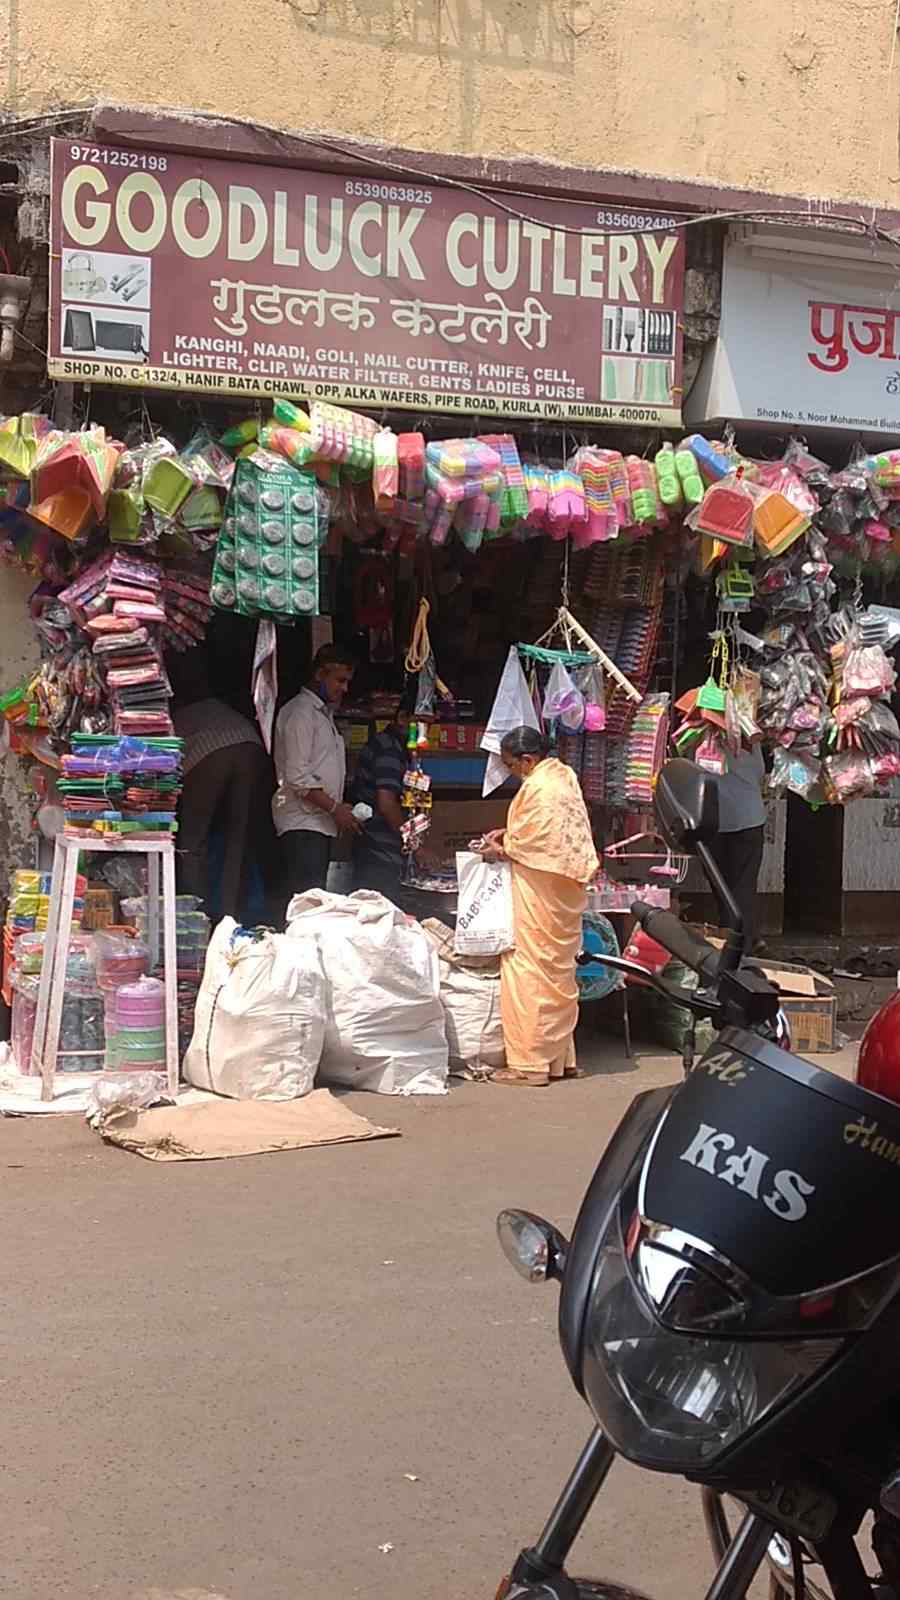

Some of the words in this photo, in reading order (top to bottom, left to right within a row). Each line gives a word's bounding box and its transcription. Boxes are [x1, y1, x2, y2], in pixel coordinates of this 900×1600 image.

[70, 145, 168, 172] 9721252198
[344, 180, 433, 204] 8539063825
[61, 164, 426, 281] GOODLUCK
[445, 211, 679, 304] CUTLERY
[210, 278, 380, 336] गुडलक
[390, 292, 552, 350] कटलेरी
[163, 352, 243, 373] LIGHTER,
[248, 359, 288, 377] CLIP,
[293, 363, 349, 380] WATER
[355, 369, 414, 387] FILTER,
[419, 375, 472, 391] GENTS
[476, 378, 531, 395] LADIES
[537, 385, 585, 400] PURSE
[175, 335, 249, 356] KANGHI,
[253, 342, 310, 362] NAADI,
[315, 348, 359, 366] GOLI,
[364, 353, 401, 368] NAIL
[406, 356, 474, 377] CUTTER,
[478, 363, 529, 382] KNIFE,
[533, 368, 575, 385] CELL,
[64, 361, 100, 375] SHOP
[104, 365, 127, 379] NO.
[185, 372, 224, 387] HANIF
[228, 376, 260, 390] BATA
[264, 379, 312, 396] CHAWL,
[344, 387, 377, 401] ALKA
[381, 390, 432, 406] WAFERS,
[435, 394, 461, 408] PIPE
[464, 396, 499, 412] ROAD,
[502, 401, 541, 414] KURLA
[544, 401, 565, 417] (W),
[757, 408, 780, 419] Shop
[808, 412, 828, 422] Noor
[830, 415, 878, 427] Mohammad
[679, 1123, 816, 1222] KAS
